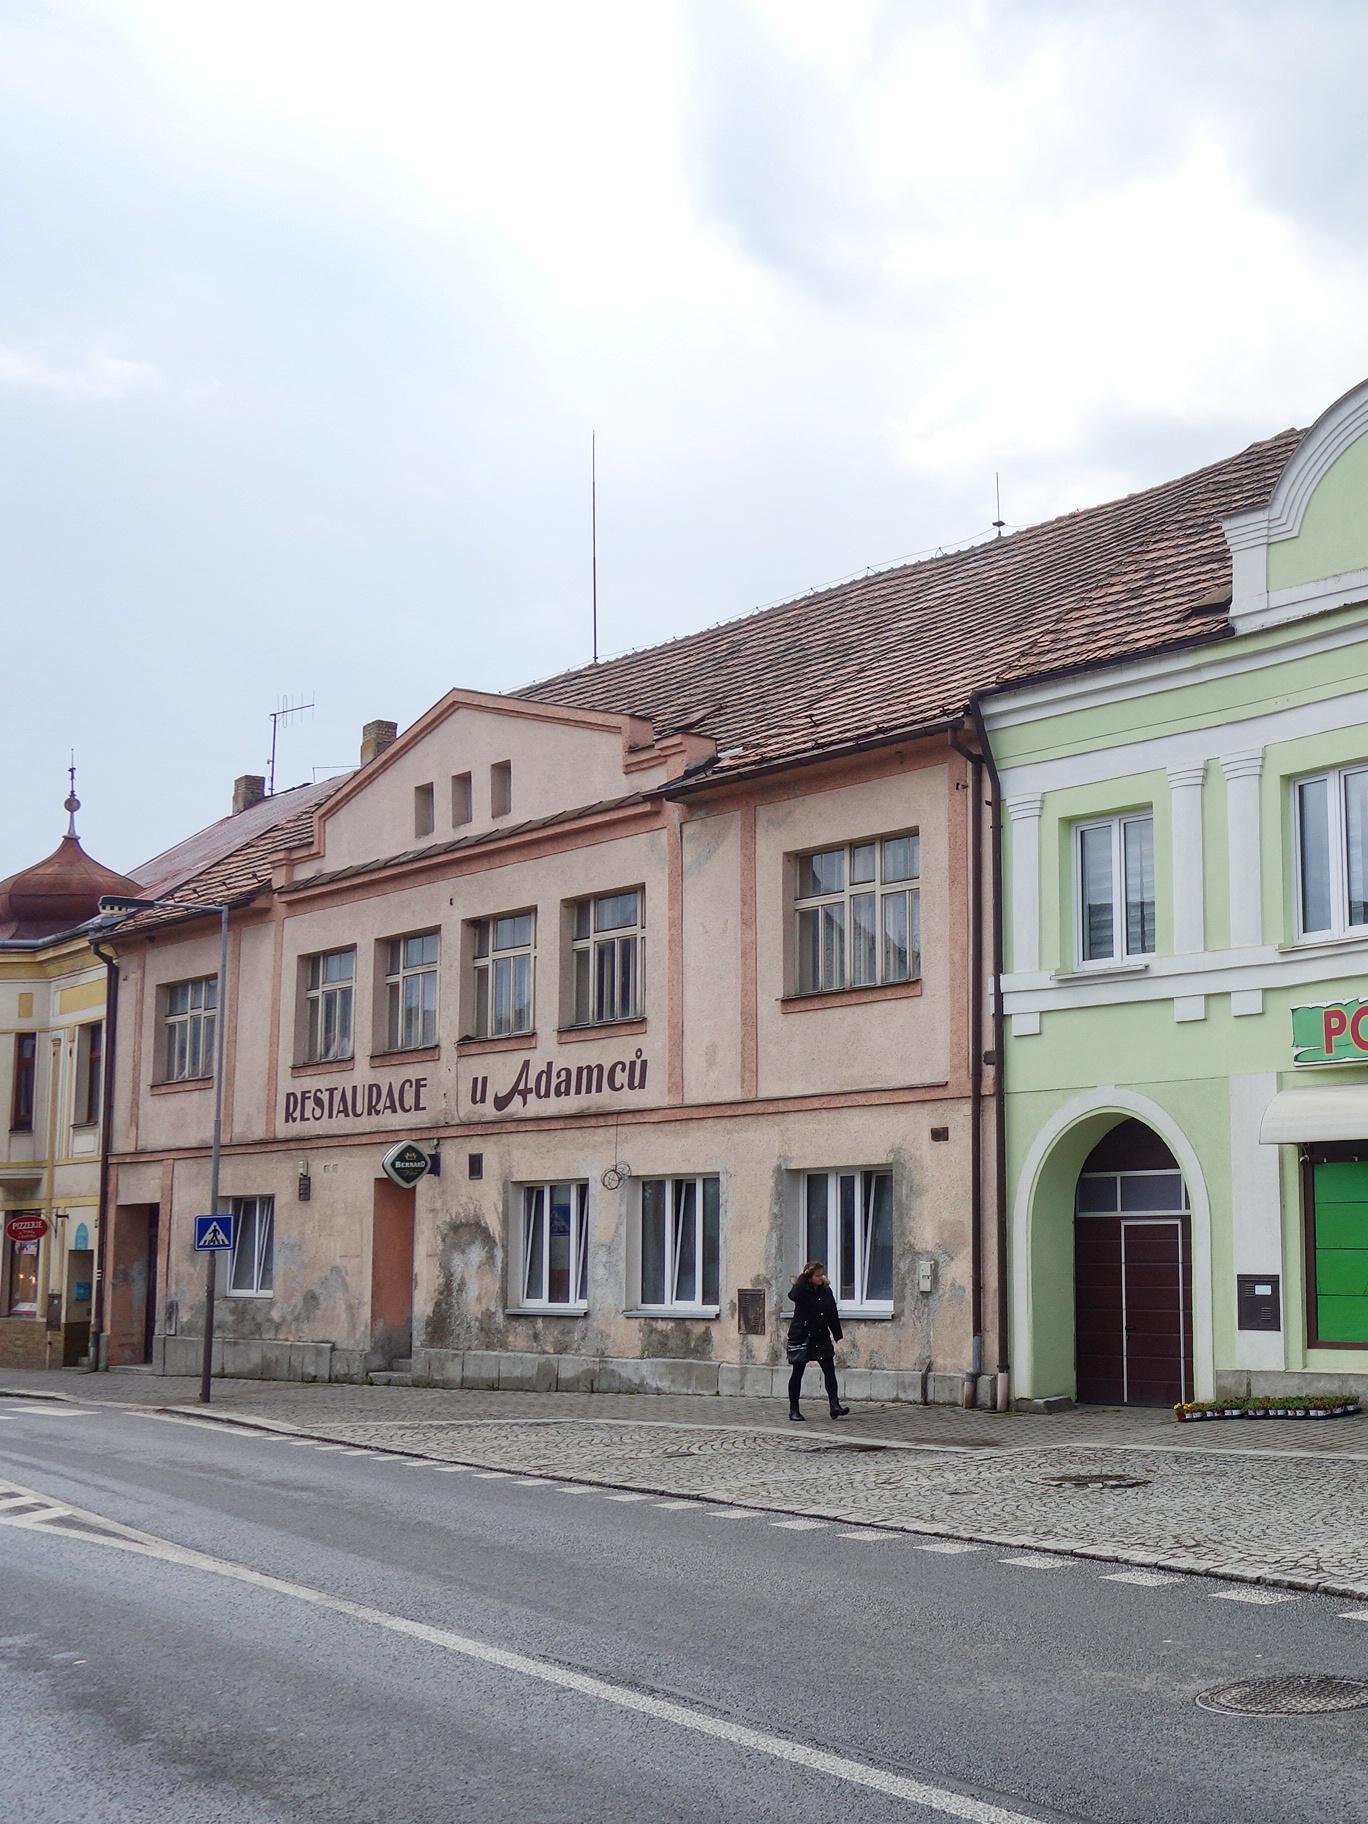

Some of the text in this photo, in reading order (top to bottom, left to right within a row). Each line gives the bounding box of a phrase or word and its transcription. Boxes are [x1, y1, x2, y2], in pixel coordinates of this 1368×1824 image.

[284, 1047, 649, 1123] RESTAURACE u Adamců
